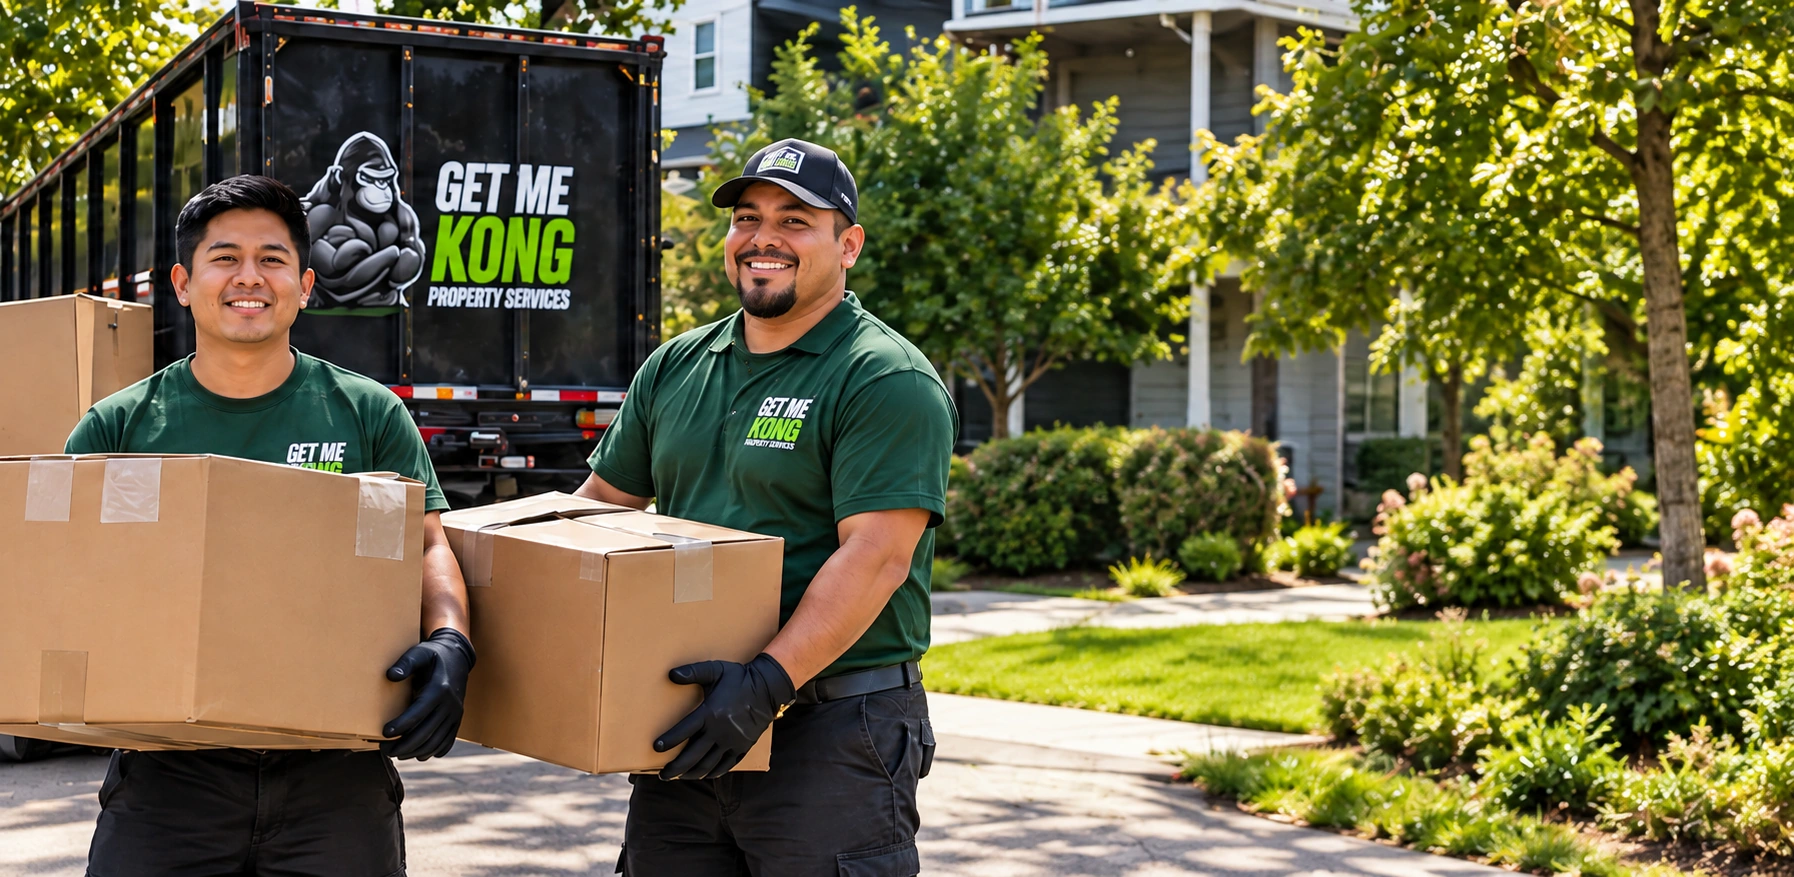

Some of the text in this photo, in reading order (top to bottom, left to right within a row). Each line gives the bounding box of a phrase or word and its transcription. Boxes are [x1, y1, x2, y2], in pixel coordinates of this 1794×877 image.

[435, 161, 574, 215] GET ME
[430, 215, 575, 285] KONG
[427, 286, 571, 310] PROPERTY SERVICES
[757, 396, 813, 419] GET ME
[747, 417, 803, 442] KONG
[286, 442, 347, 463] GET ME
